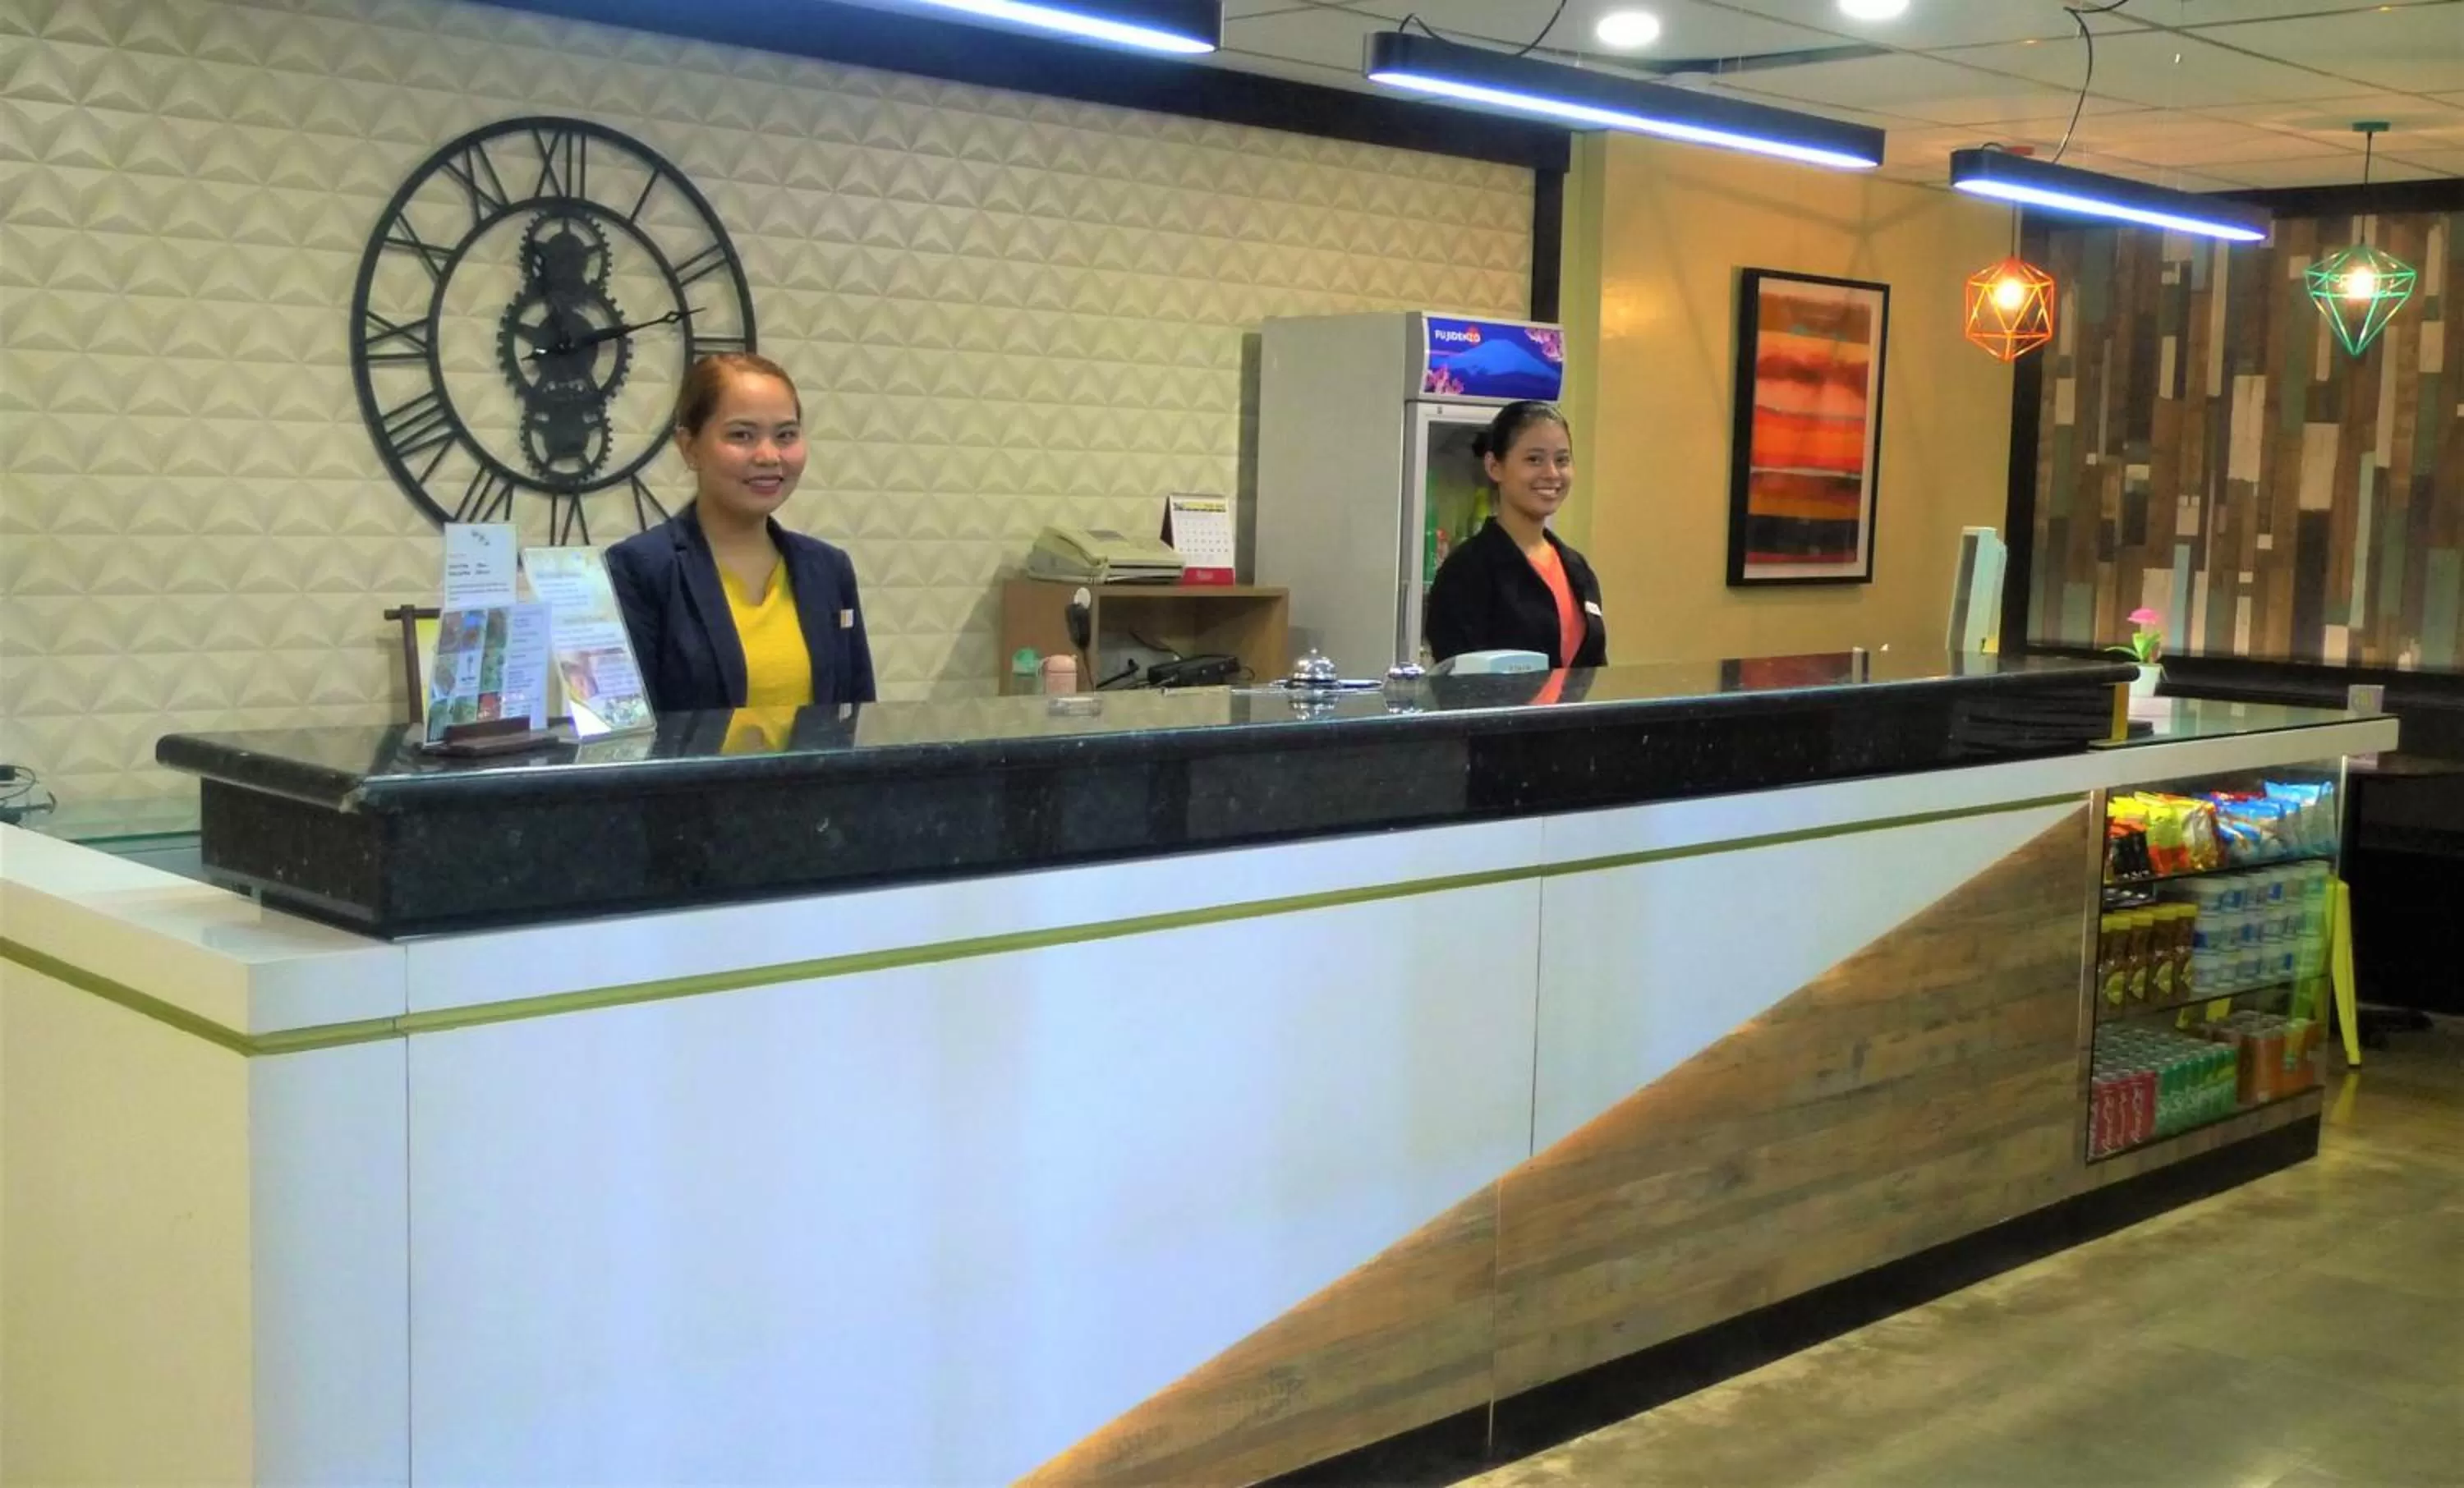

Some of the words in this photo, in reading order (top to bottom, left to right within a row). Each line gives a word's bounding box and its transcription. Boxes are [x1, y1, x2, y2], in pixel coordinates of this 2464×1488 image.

[444, 142, 511, 223] XI
[532, 129, 586, 199] XII
[383, 210, 457, 280] X
[365, 310, 430, 361] IX
